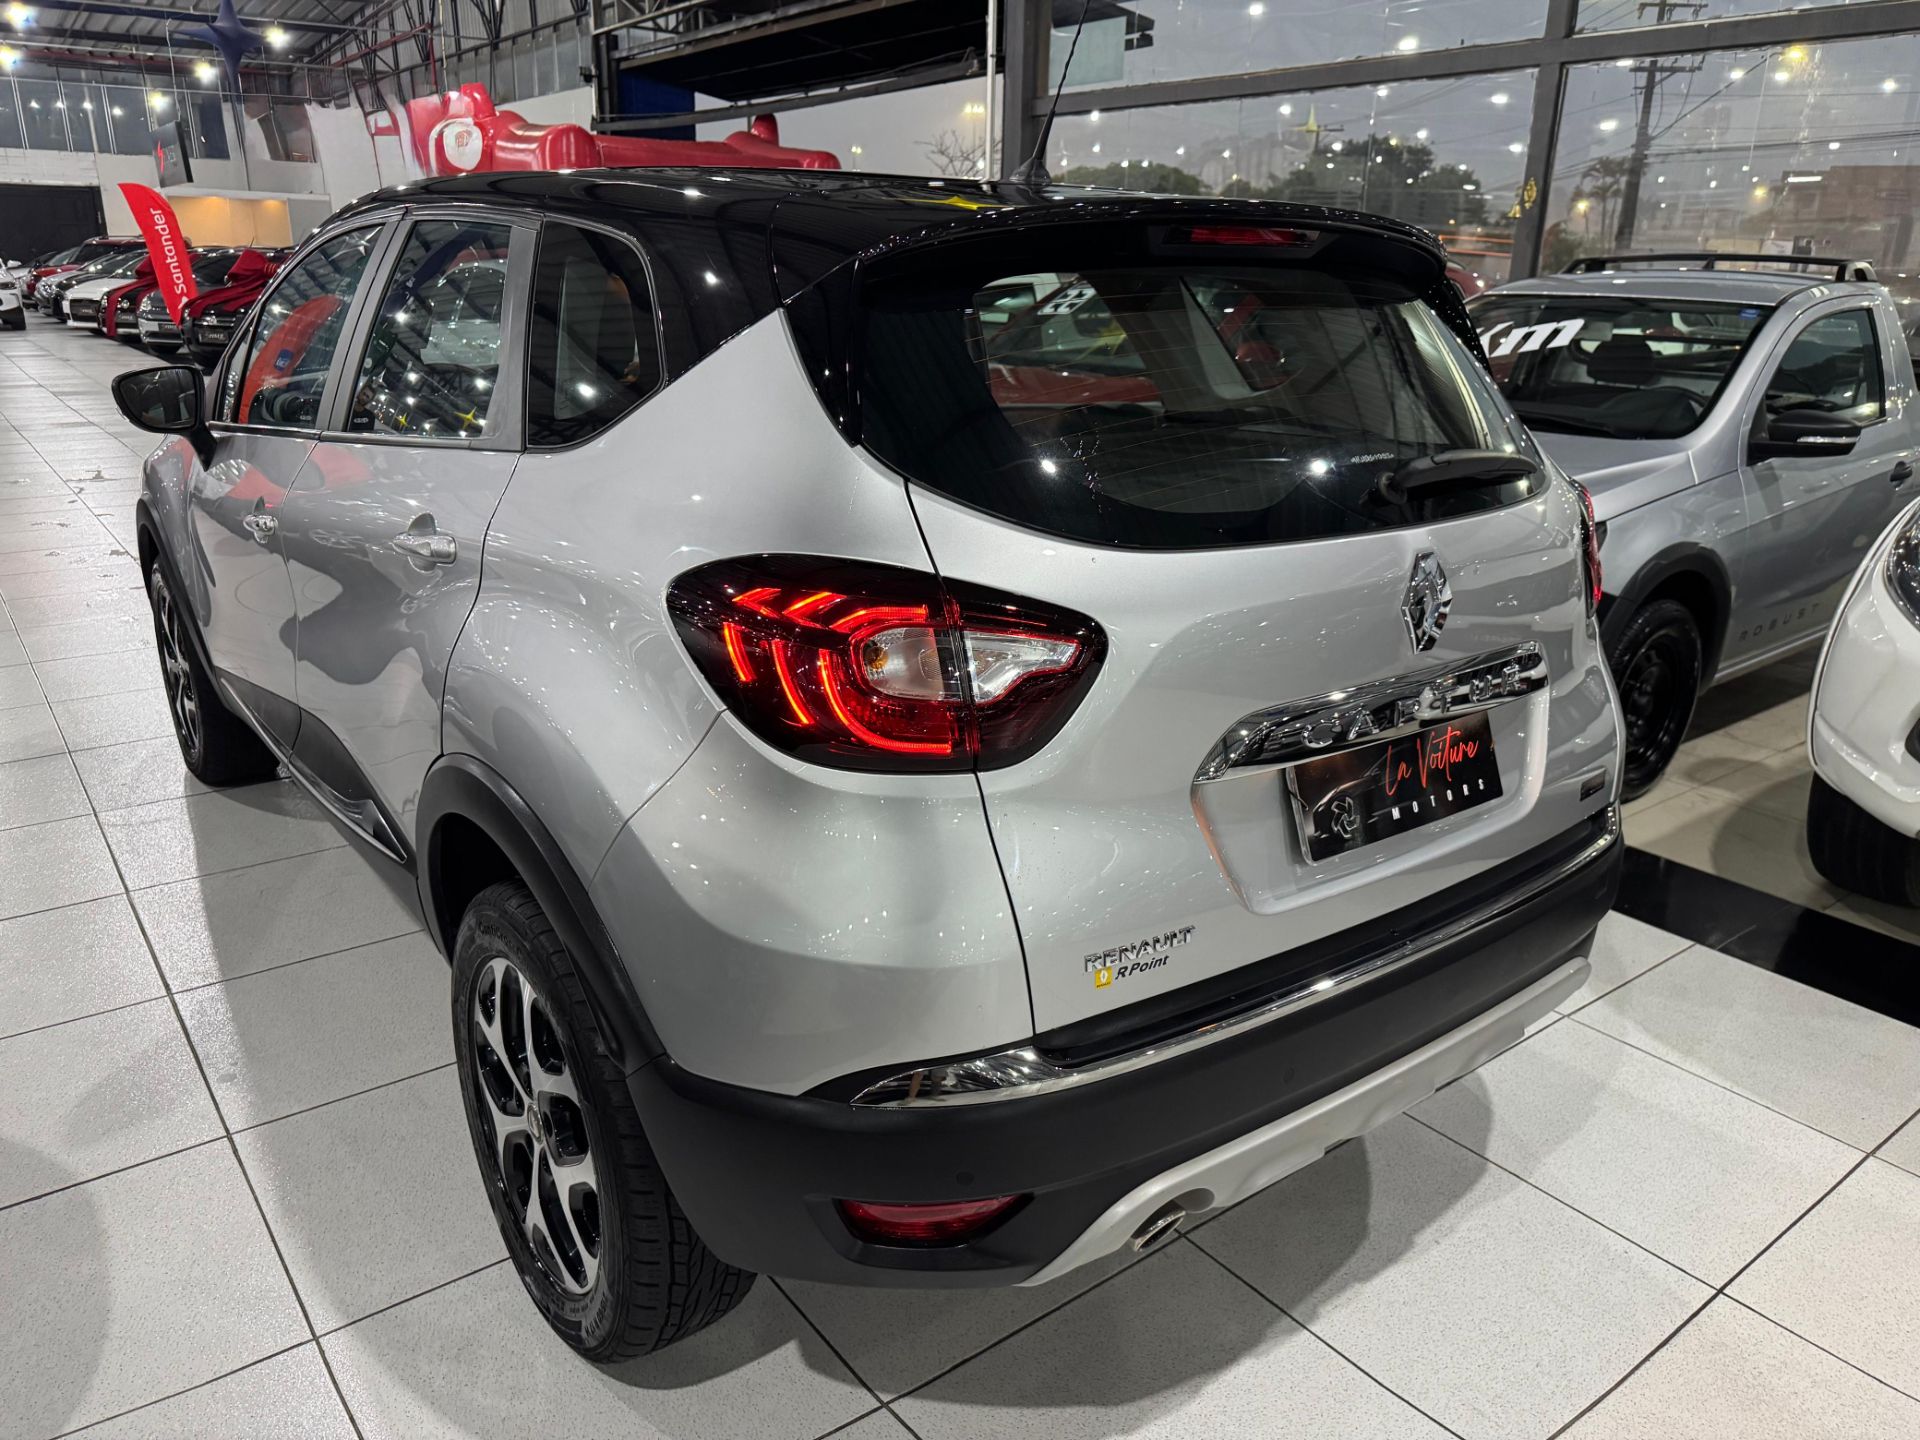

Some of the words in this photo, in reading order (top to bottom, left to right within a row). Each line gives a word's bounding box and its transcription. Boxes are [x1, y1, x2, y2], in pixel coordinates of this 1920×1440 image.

[150, 207, 187, 294] Santander
[1738, 602, 1820, 641] ROBUST
[1300, 663, 1521, 749] CAPTUR
[1385, 745, 1413, 796] La
[1416, 726, 1479, 788] Voiture
[1391, 779, 1485, 820] MOTORS
[1084, 925, 1196, 973] RENAULT
